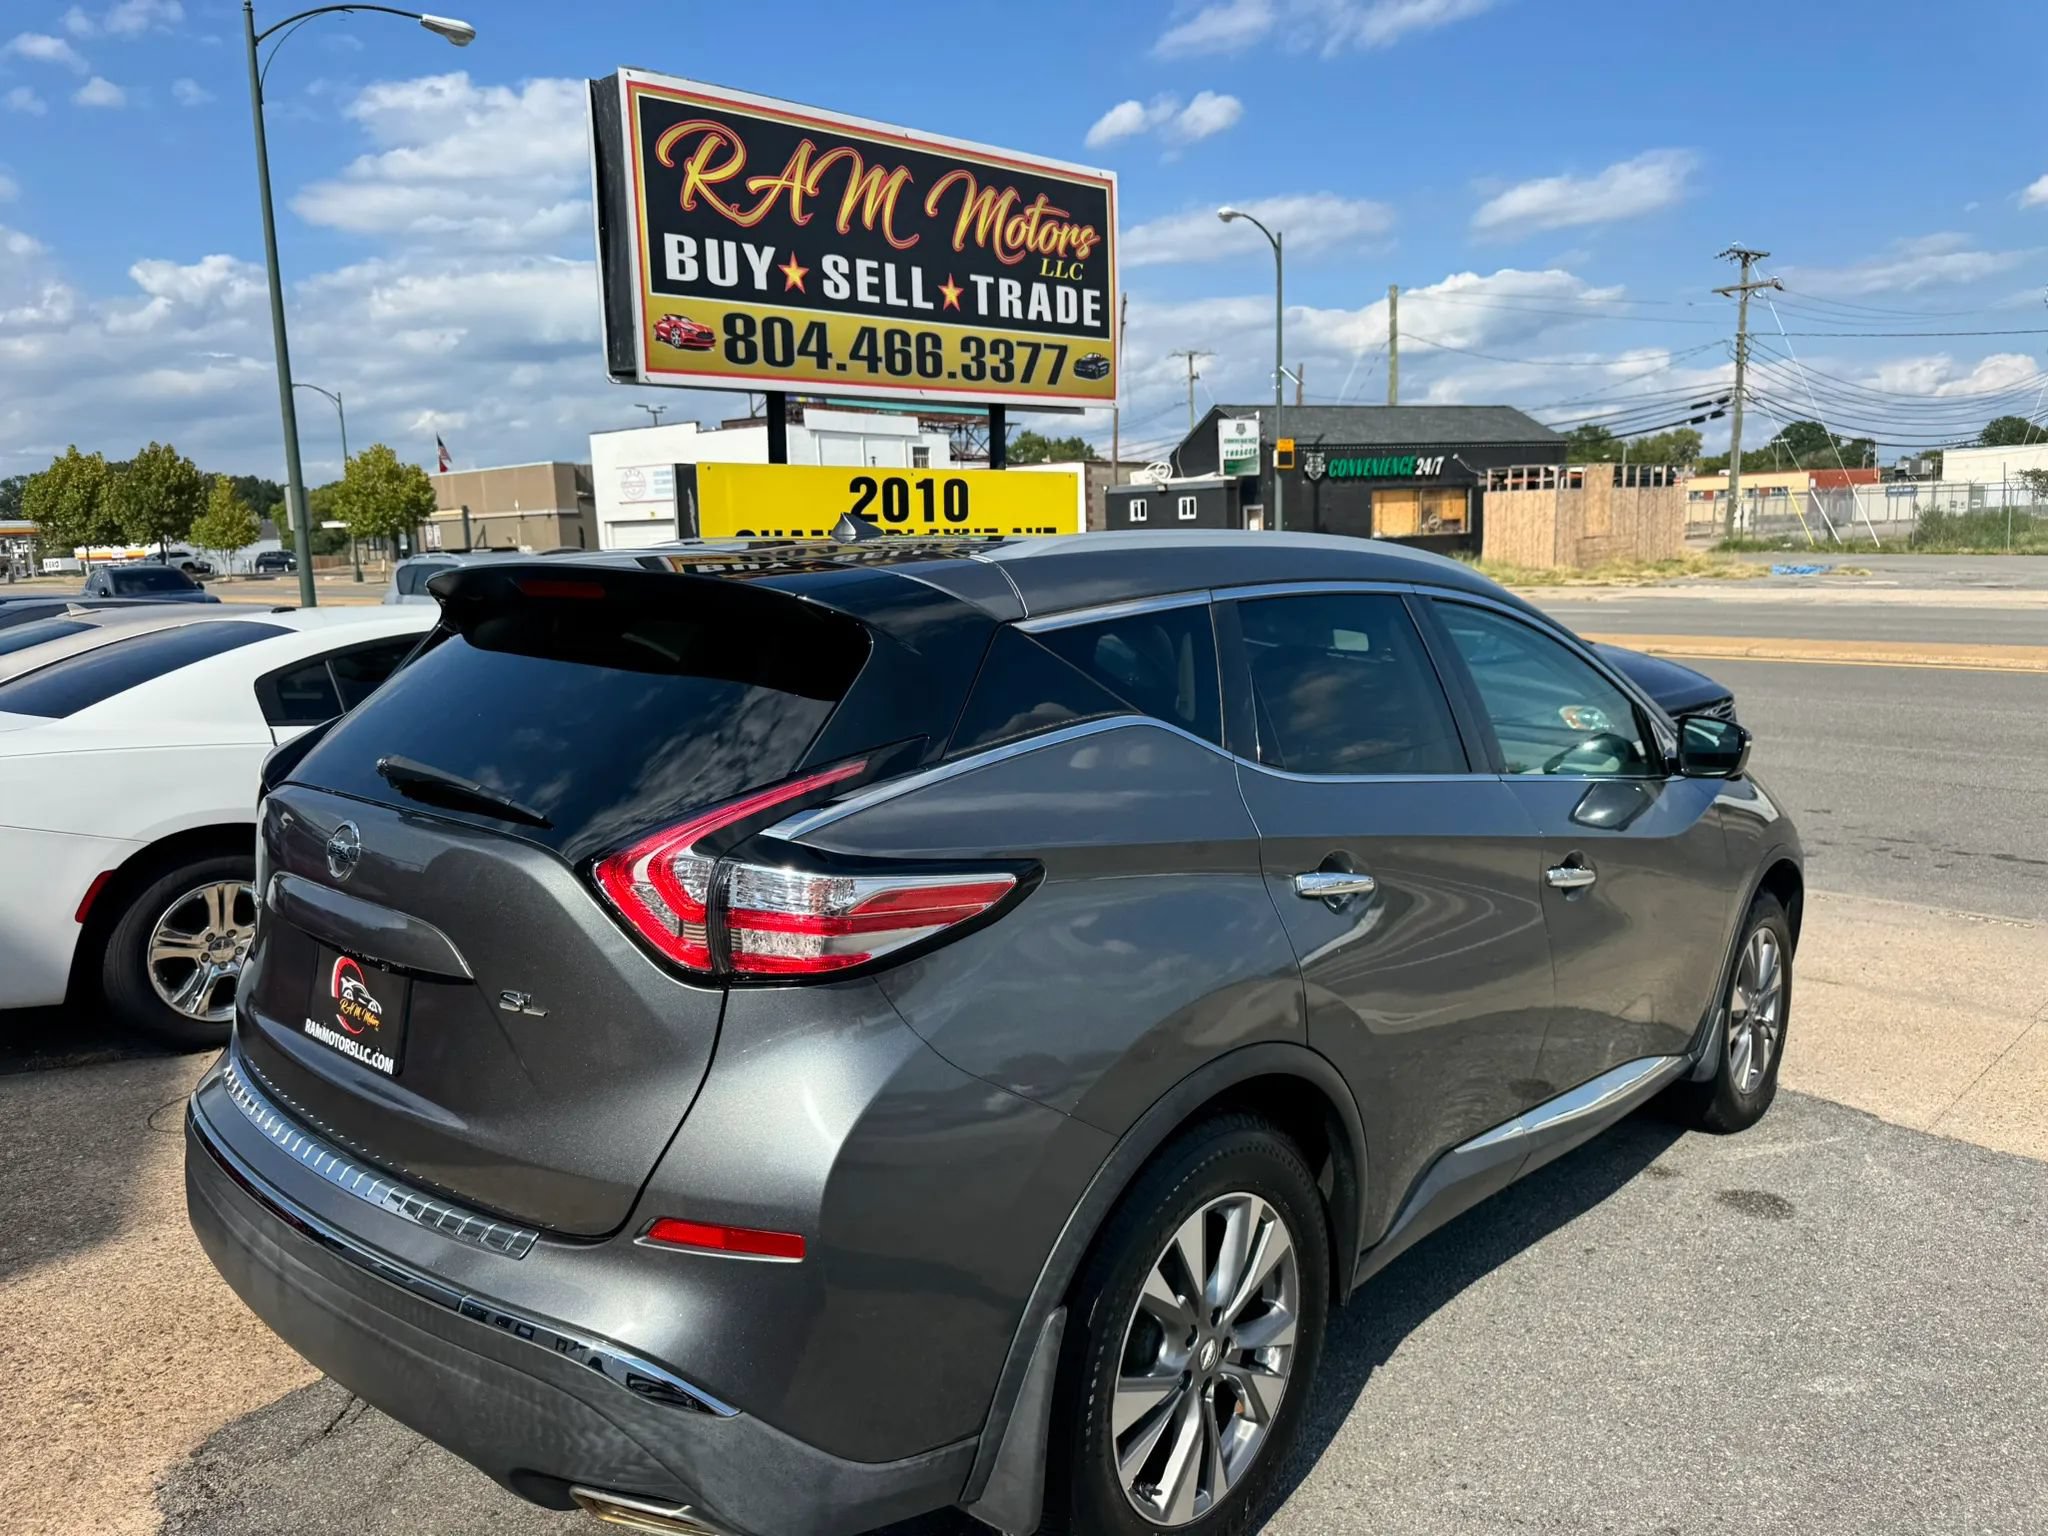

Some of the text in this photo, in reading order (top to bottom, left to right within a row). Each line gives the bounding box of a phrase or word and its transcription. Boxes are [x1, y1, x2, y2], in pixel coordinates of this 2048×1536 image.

[655, 119, 1100, 265] RAM Motors
[663, 232, 1101, 328] BUY SELL TRADE
[1039, 258, 1084, 281] LLC
[722, 312, 1069, 386] 804.466.3377
[1328, 455, 1445, 478] CONVENIENCE 24/7
[849, 476, 969, 523] 2010
[304, 1017, 394, 1075] RAMMOTORSLLC.COM
